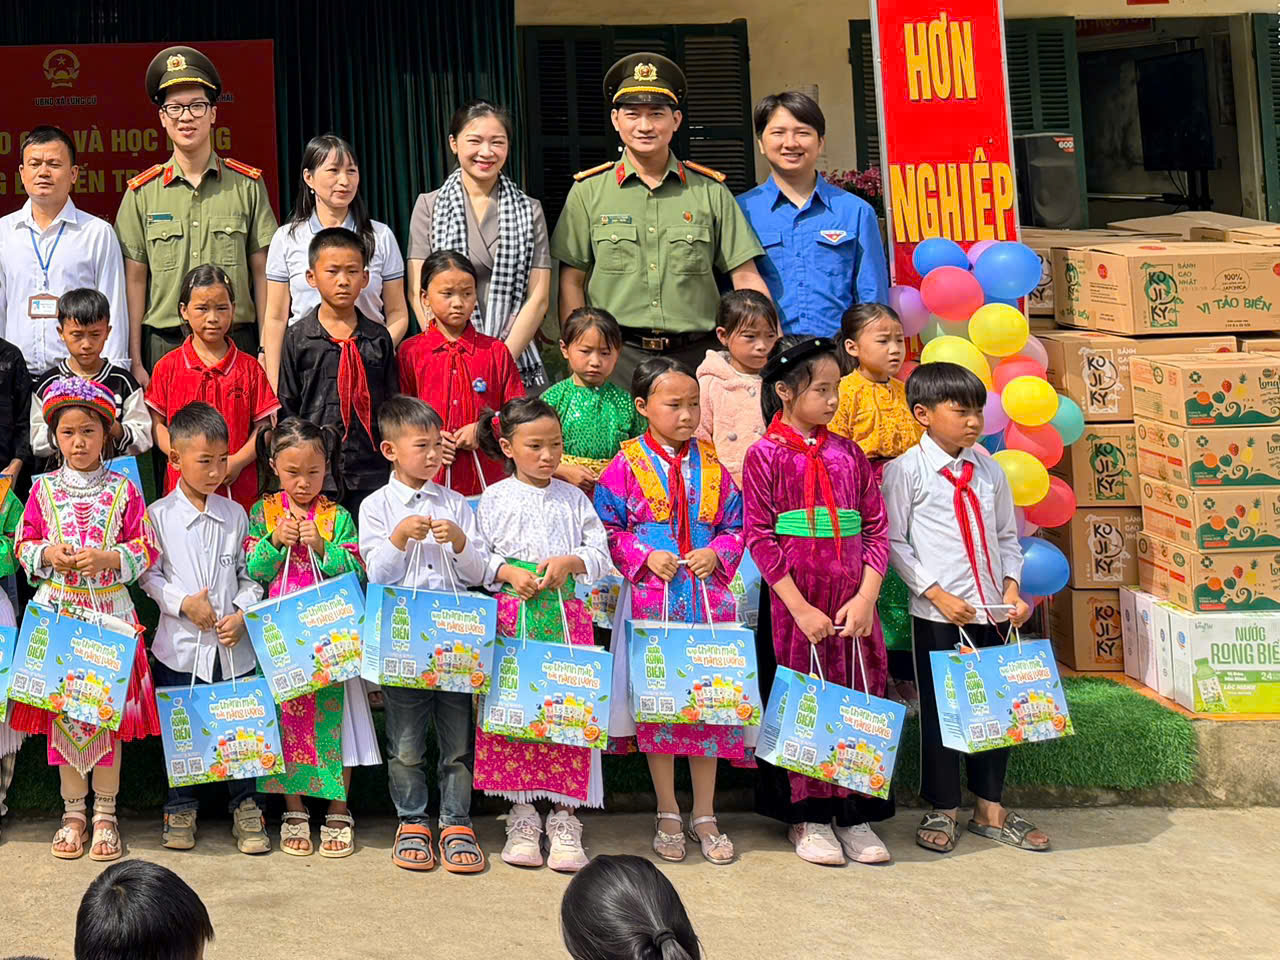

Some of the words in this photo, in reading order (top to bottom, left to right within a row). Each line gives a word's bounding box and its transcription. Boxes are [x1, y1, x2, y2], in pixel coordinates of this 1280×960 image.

[904, 11, 977, 102] HƠN
[73, 125, 104, 152] VÀ
[111, 128, 158, 157] HỌC
[890, 146, 1014, 243] NGHIỆP
[1149, 271, 1167, 286] KO
[1151, 305, 1168, 321] KY
[1087, 355, 1106, 371] KO
[1090, 391, 1108, 406] KY
[1094, 442, 1114, 457] KO
[1095, 477, 1116, 493] KY
[1093, 523, 1112, 538] KO
[1094, 541, 1108, 555] JI
[1095, 559, 1113, 574] KY
[1095, 605, 1113, 620] KO
[1096, 623, 1109, 637] JI
[1235, 622, 1266, 641] NƯỚC
[1096, 641, 1115, 657] KY
[1211, 643, 1254, 664] RONG
[1261, 672, 1272, 680] 24
